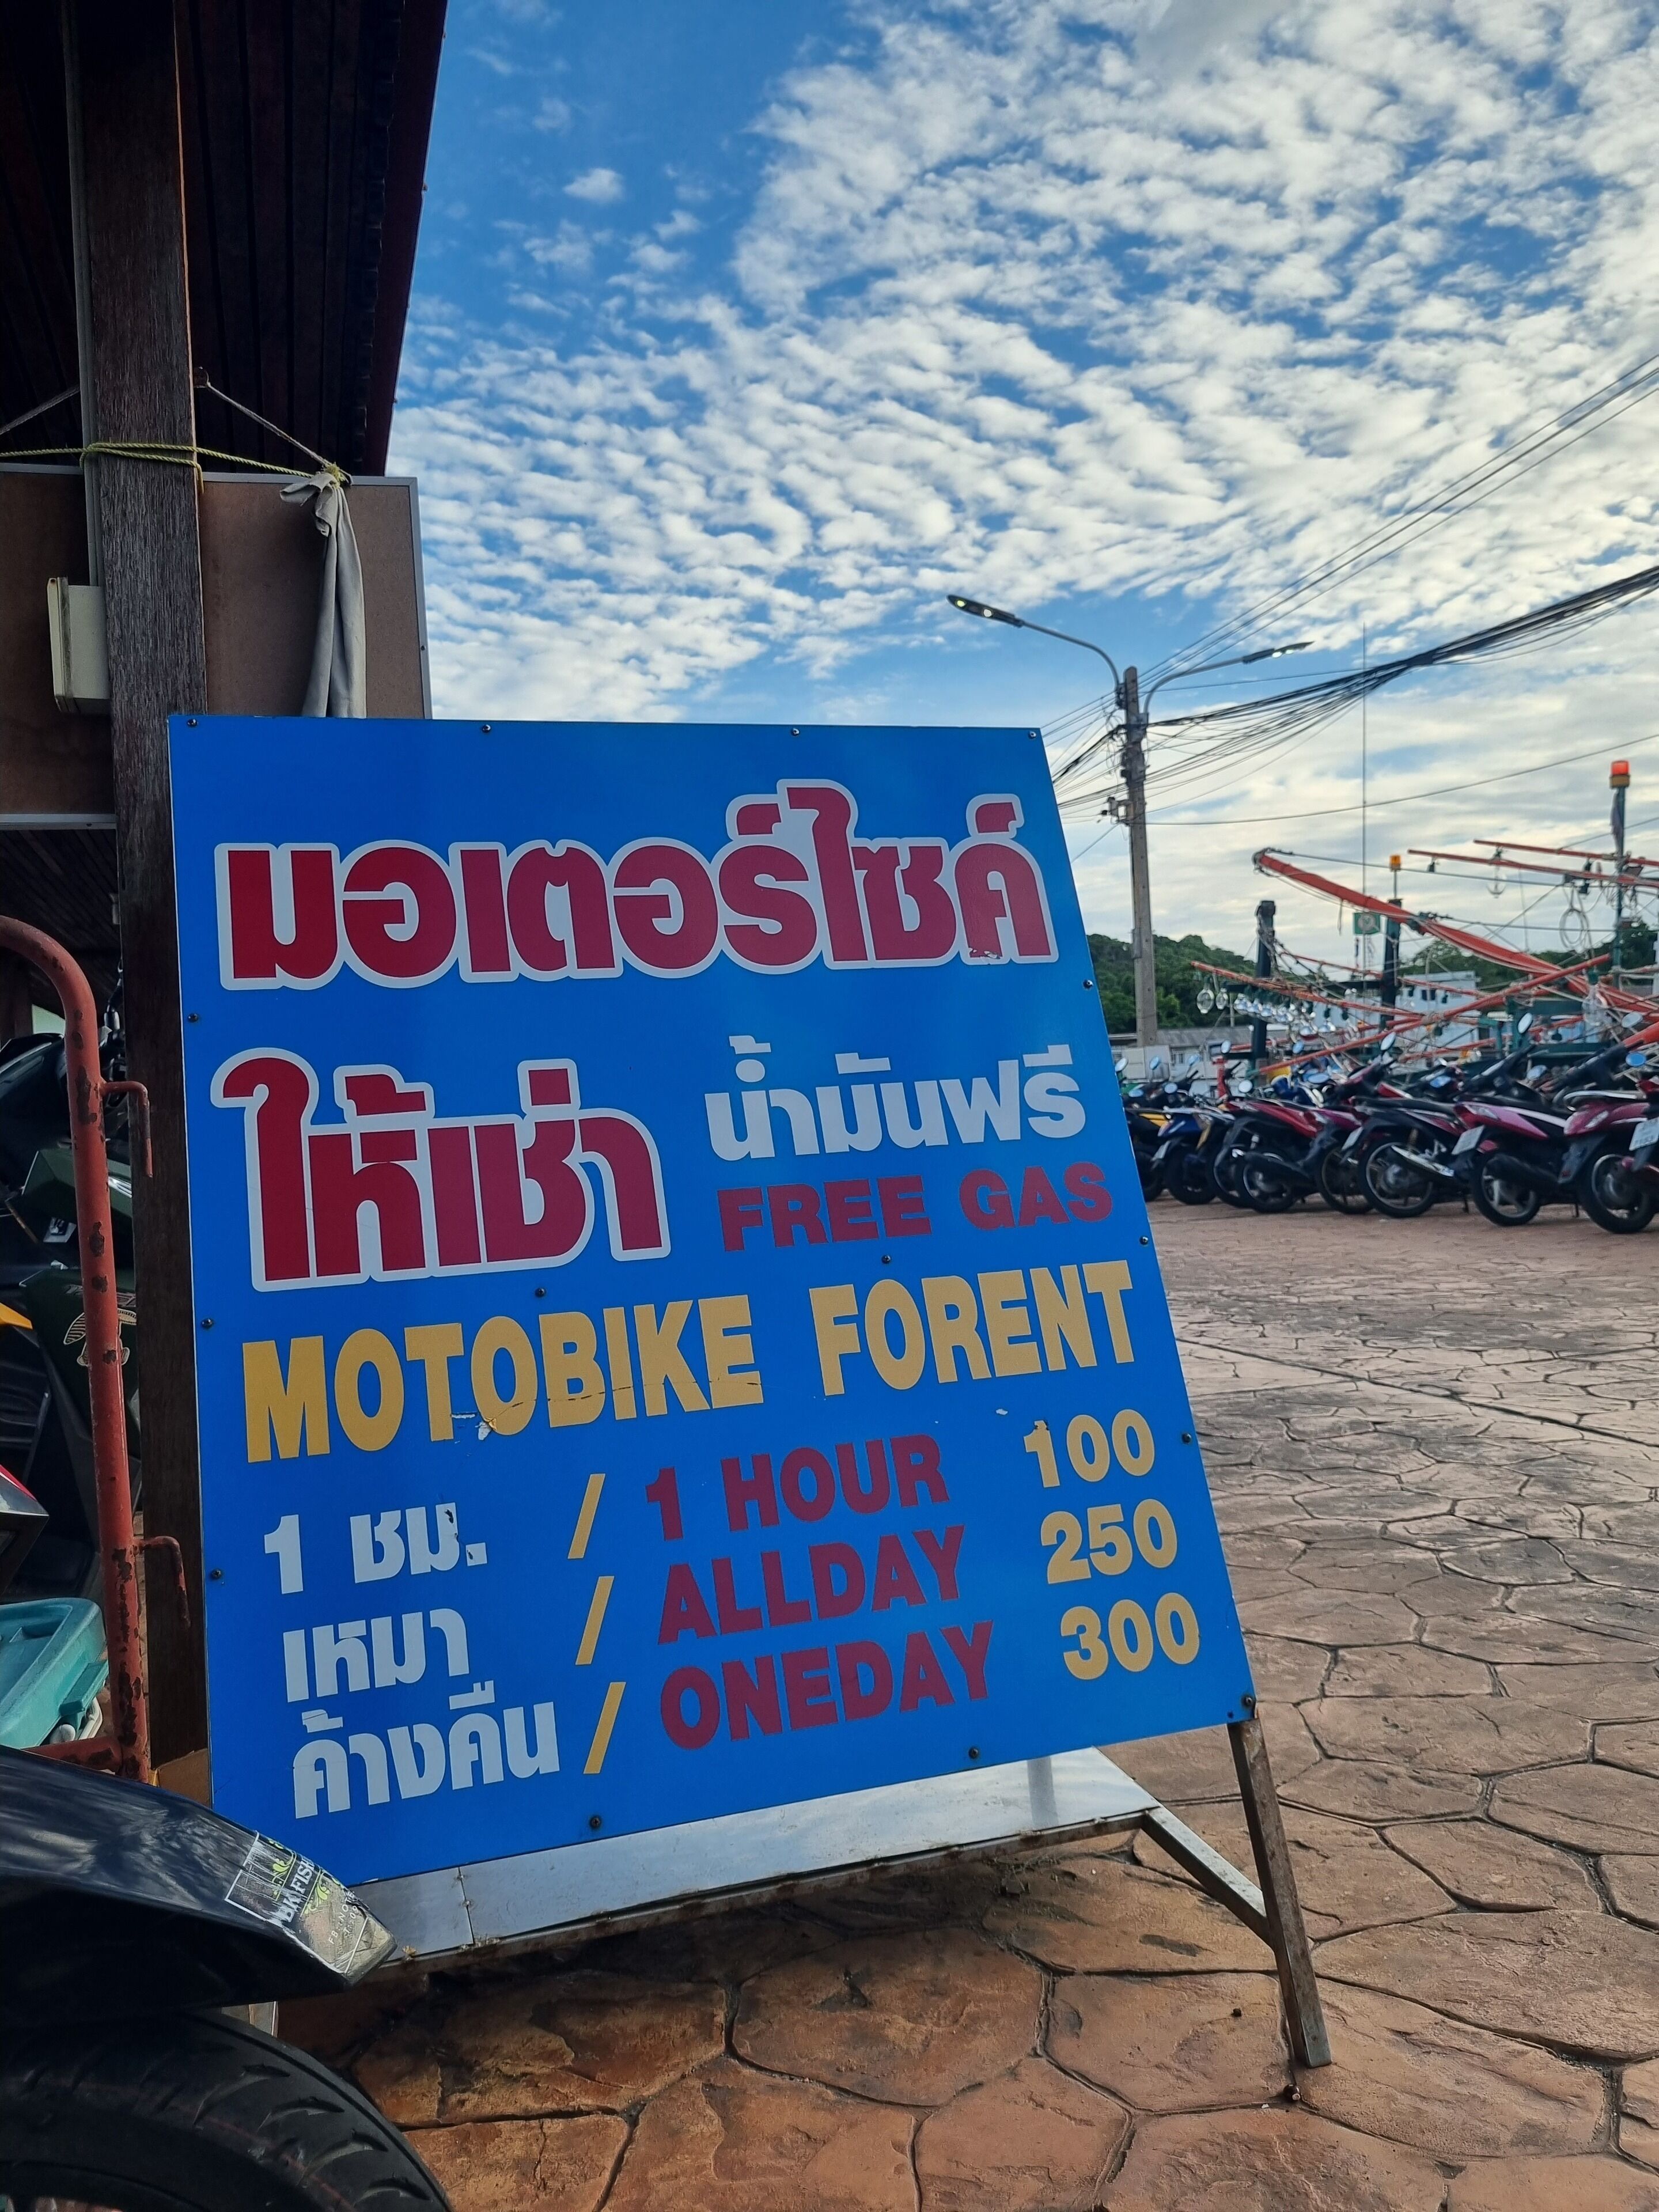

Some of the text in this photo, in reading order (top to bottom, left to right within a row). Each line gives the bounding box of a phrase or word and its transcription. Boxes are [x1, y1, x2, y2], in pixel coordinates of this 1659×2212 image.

[214, 779, 1059, 990] มอเตอร์ไซค์
[210, 1048, 671, 1291] ให้เช่า
[705, 1036, 1085, 1161] น้ำมันฟรี
[718, 1162, 1113, 1251] FREE GAS
[243, 1260, 1134, 1463] MOTOBIKE FORENT
[264, 1515, 303, 1594] 1
[350, 1502, 487, 1583] ชม.
[645, 1467, 683, 1541] 1
[721, 1434, 949, 1531] HOUR
[1024, 1410, 1154, 1487] 100
[283, 1609, 469, 1702] เหมา
[658, 1525, 965, 1645] ALLDAY
[1041, 1499, 1177, 1584] 250
[293, 1680, 560, 1819] ค้างคืน
[660, 1620, 993, 1749] ONEDAY
[1060, 1593, 1199, 1680] 300
